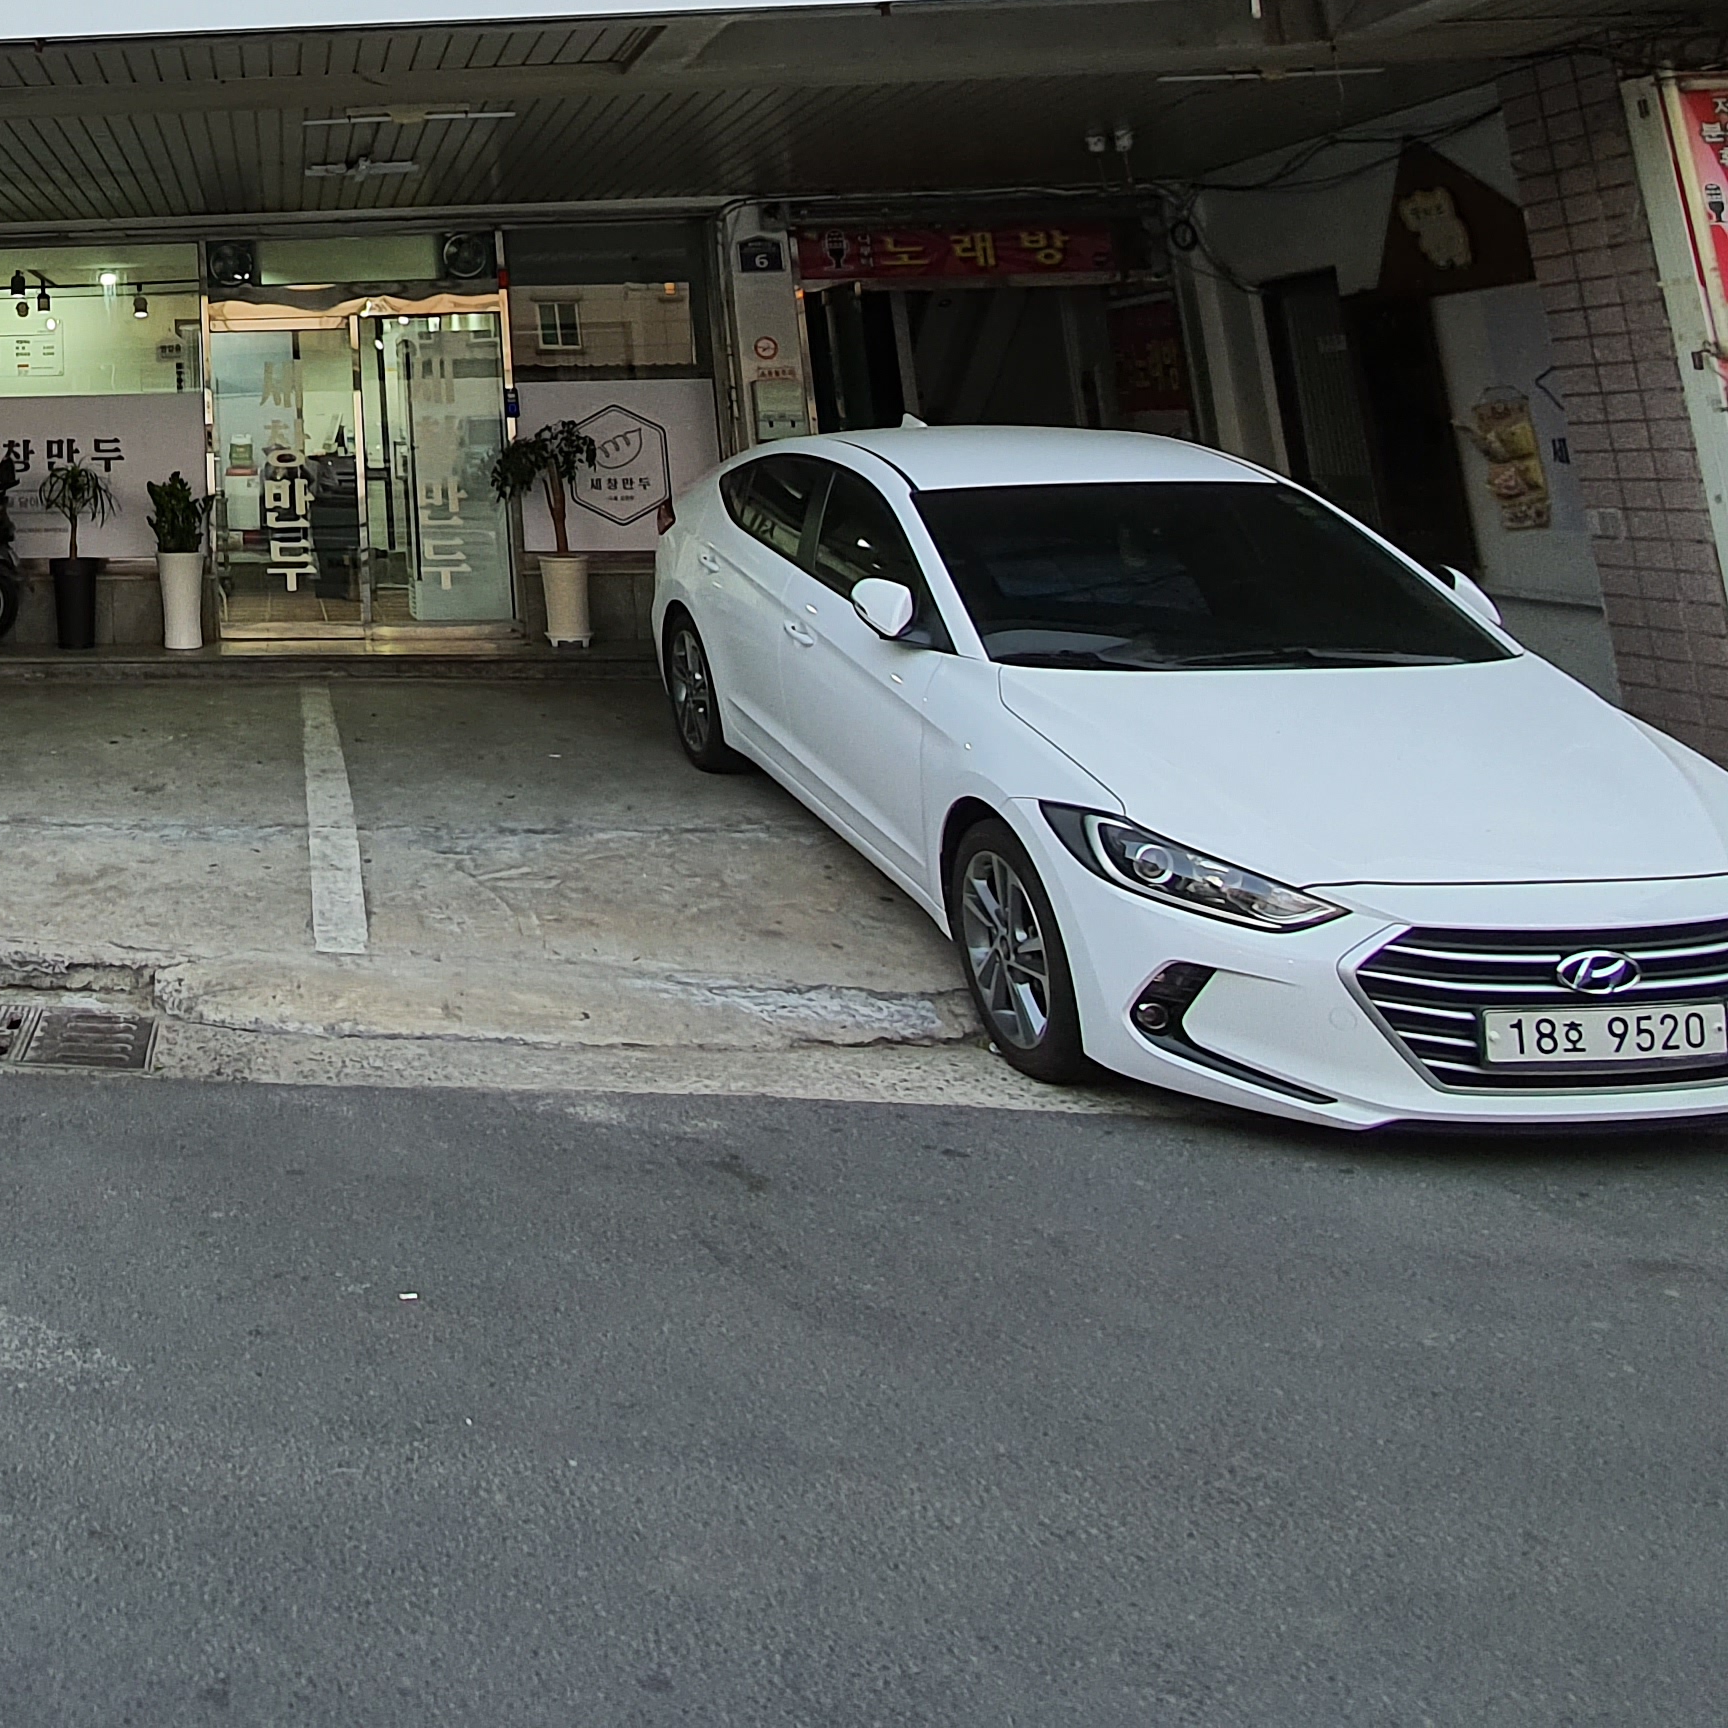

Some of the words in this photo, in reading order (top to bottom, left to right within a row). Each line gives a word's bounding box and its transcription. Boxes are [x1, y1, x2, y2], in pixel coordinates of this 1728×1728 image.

[754, 253, 769, 268] 6
[881, 228, 1071, 269] 노래방
[1509, 1018, 1587, 1055] 18호
[1607, 1012, 1706, 1053] 9520
